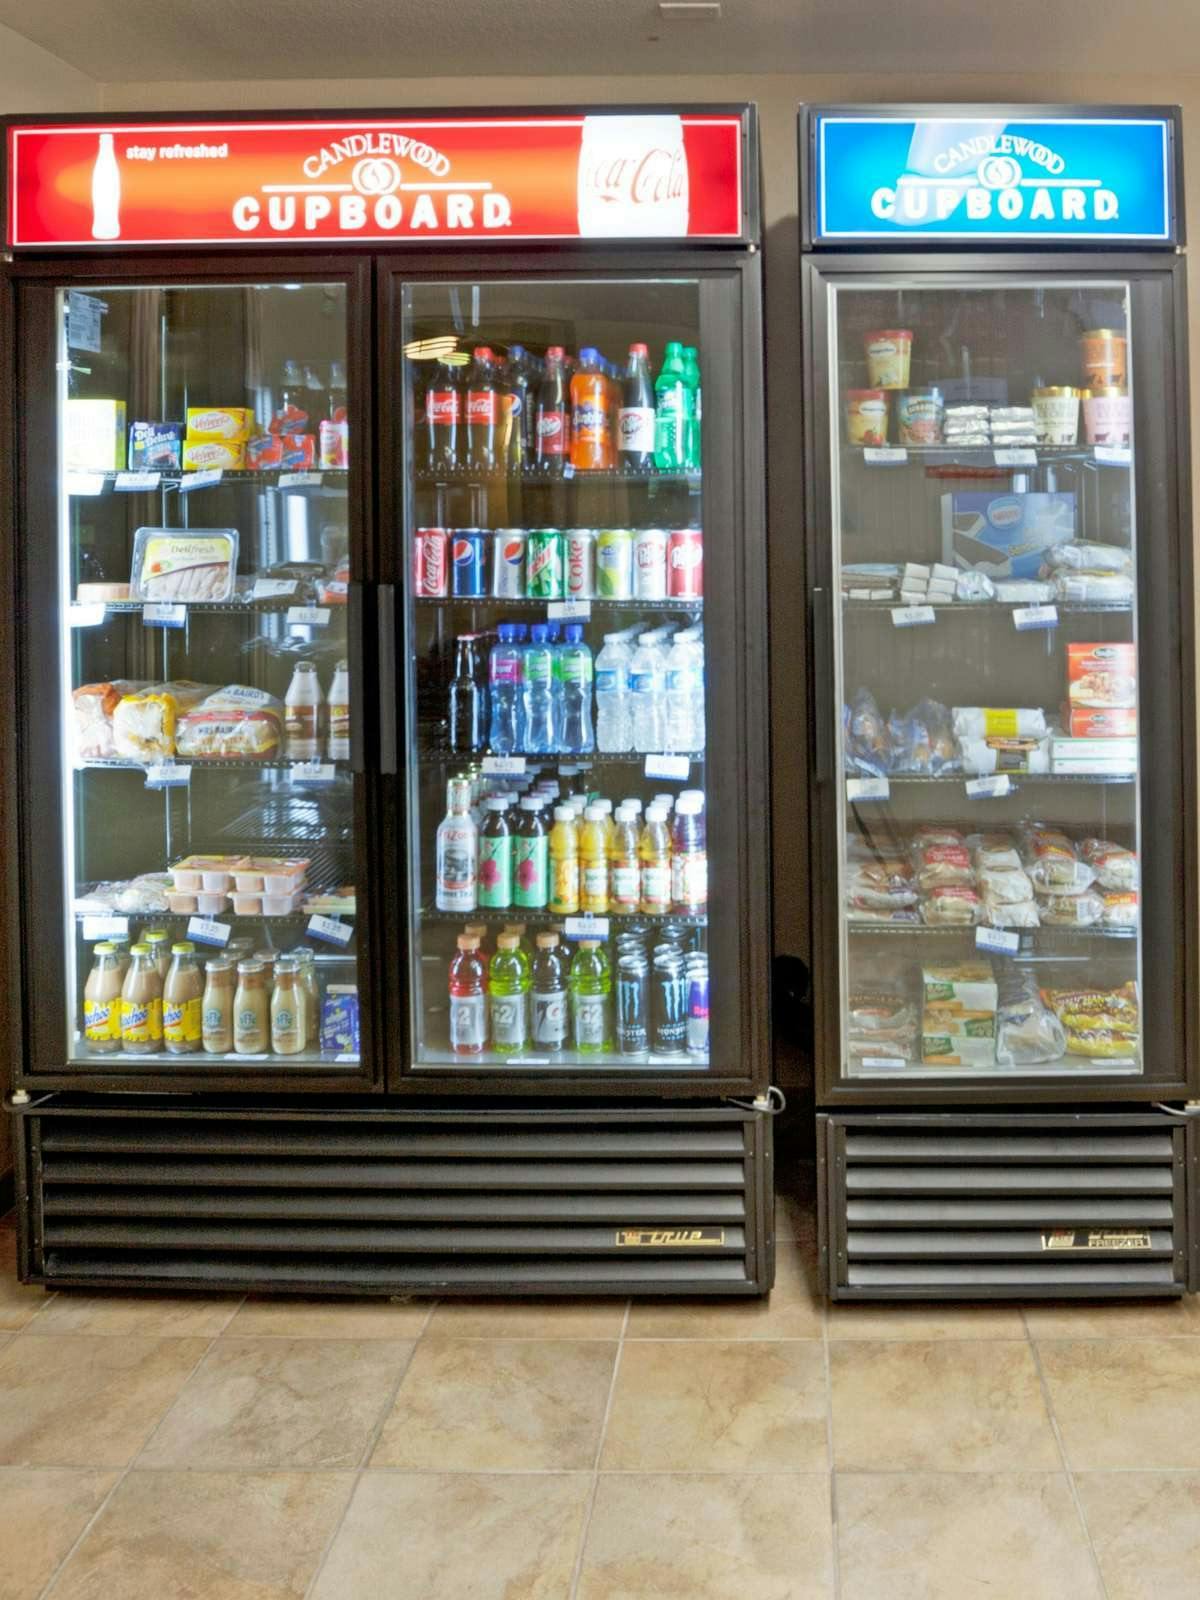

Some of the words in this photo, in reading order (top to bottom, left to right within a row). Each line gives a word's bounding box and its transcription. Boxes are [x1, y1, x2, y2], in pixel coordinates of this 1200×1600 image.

[126, 146, 157, 161] stay
[159, 143, 229, 158] refreshed
[303, 133, 450, 178] CANDLEWOOD
[934, 135, 1066, 174] CANDLEWOOD
[232, 194, 511, 231] CUPBOARD
[871, 187, 1119, 220] CUPBOARD
[568, 540, 584, 592] Coke
